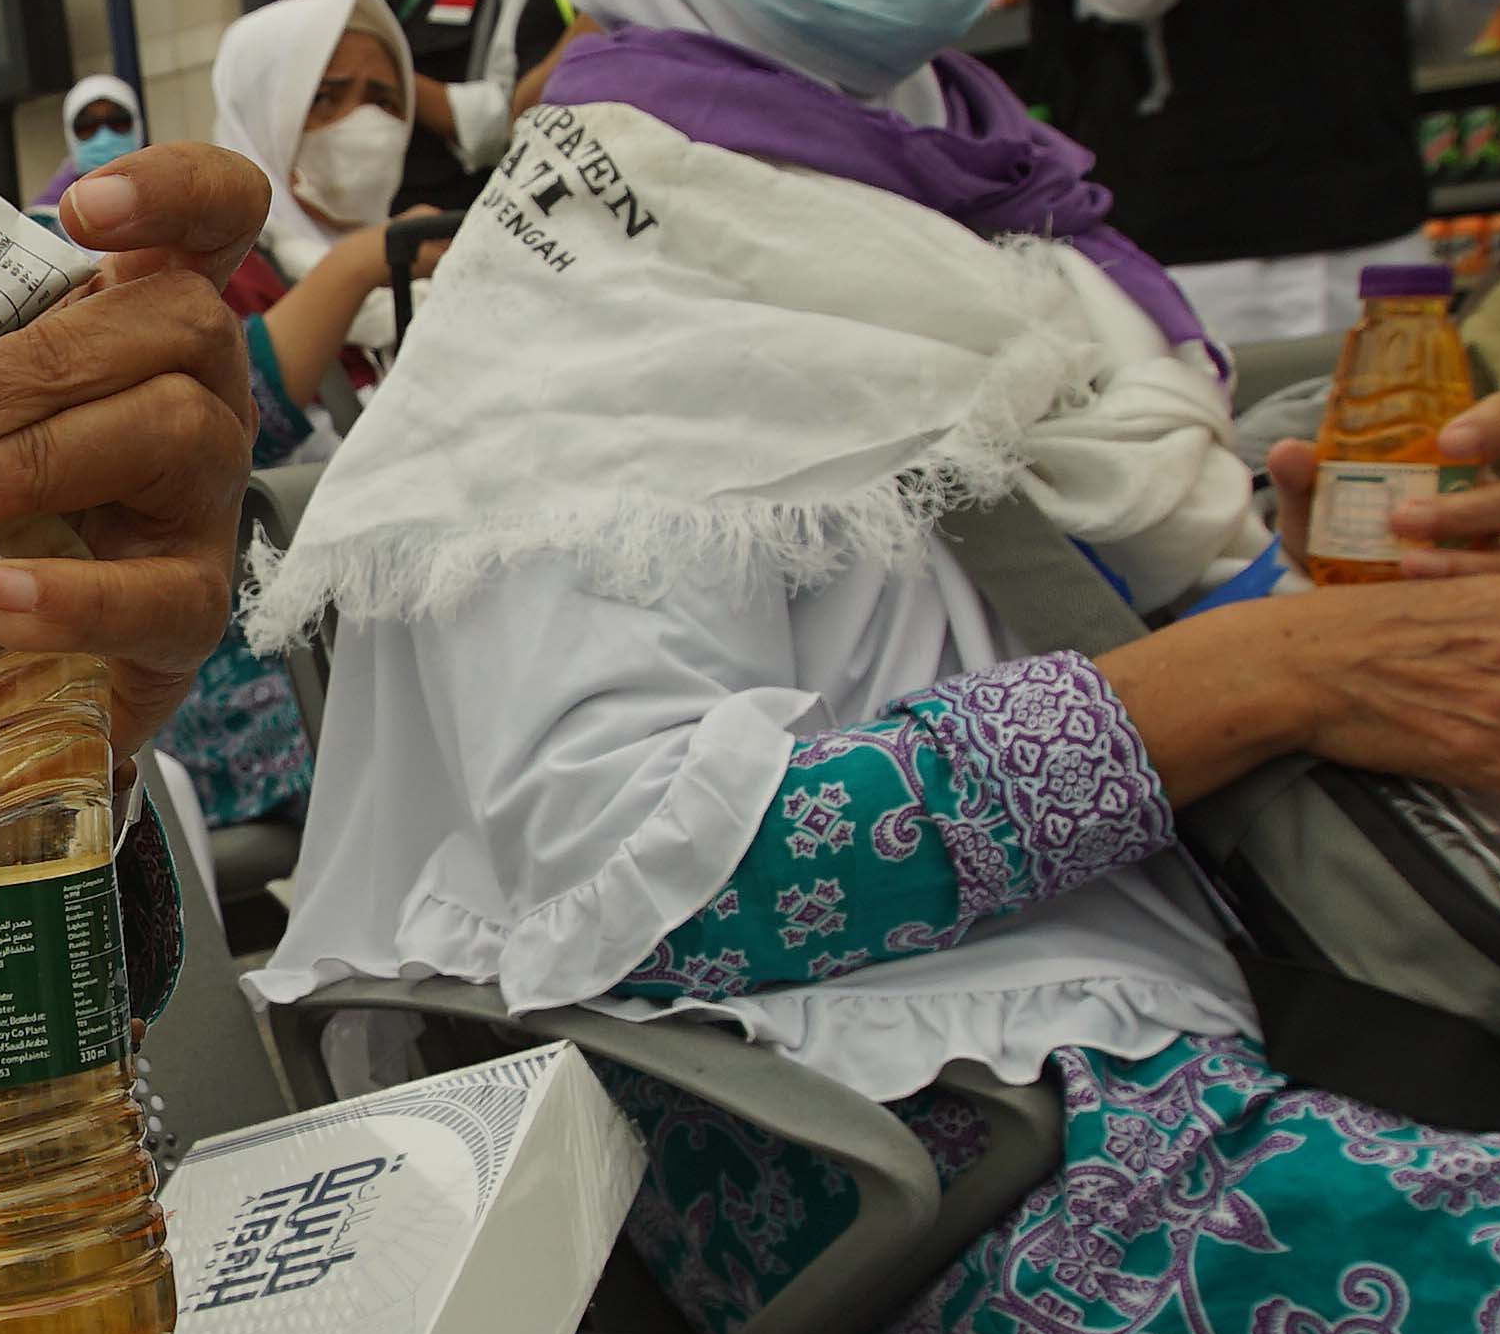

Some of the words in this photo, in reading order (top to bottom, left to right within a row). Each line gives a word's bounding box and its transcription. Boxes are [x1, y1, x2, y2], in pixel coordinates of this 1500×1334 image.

[11, 1028, 24, 1038] Co
[24, 1024, 47, 1035] Plant
[78, 1049, 97, 1063] 330
